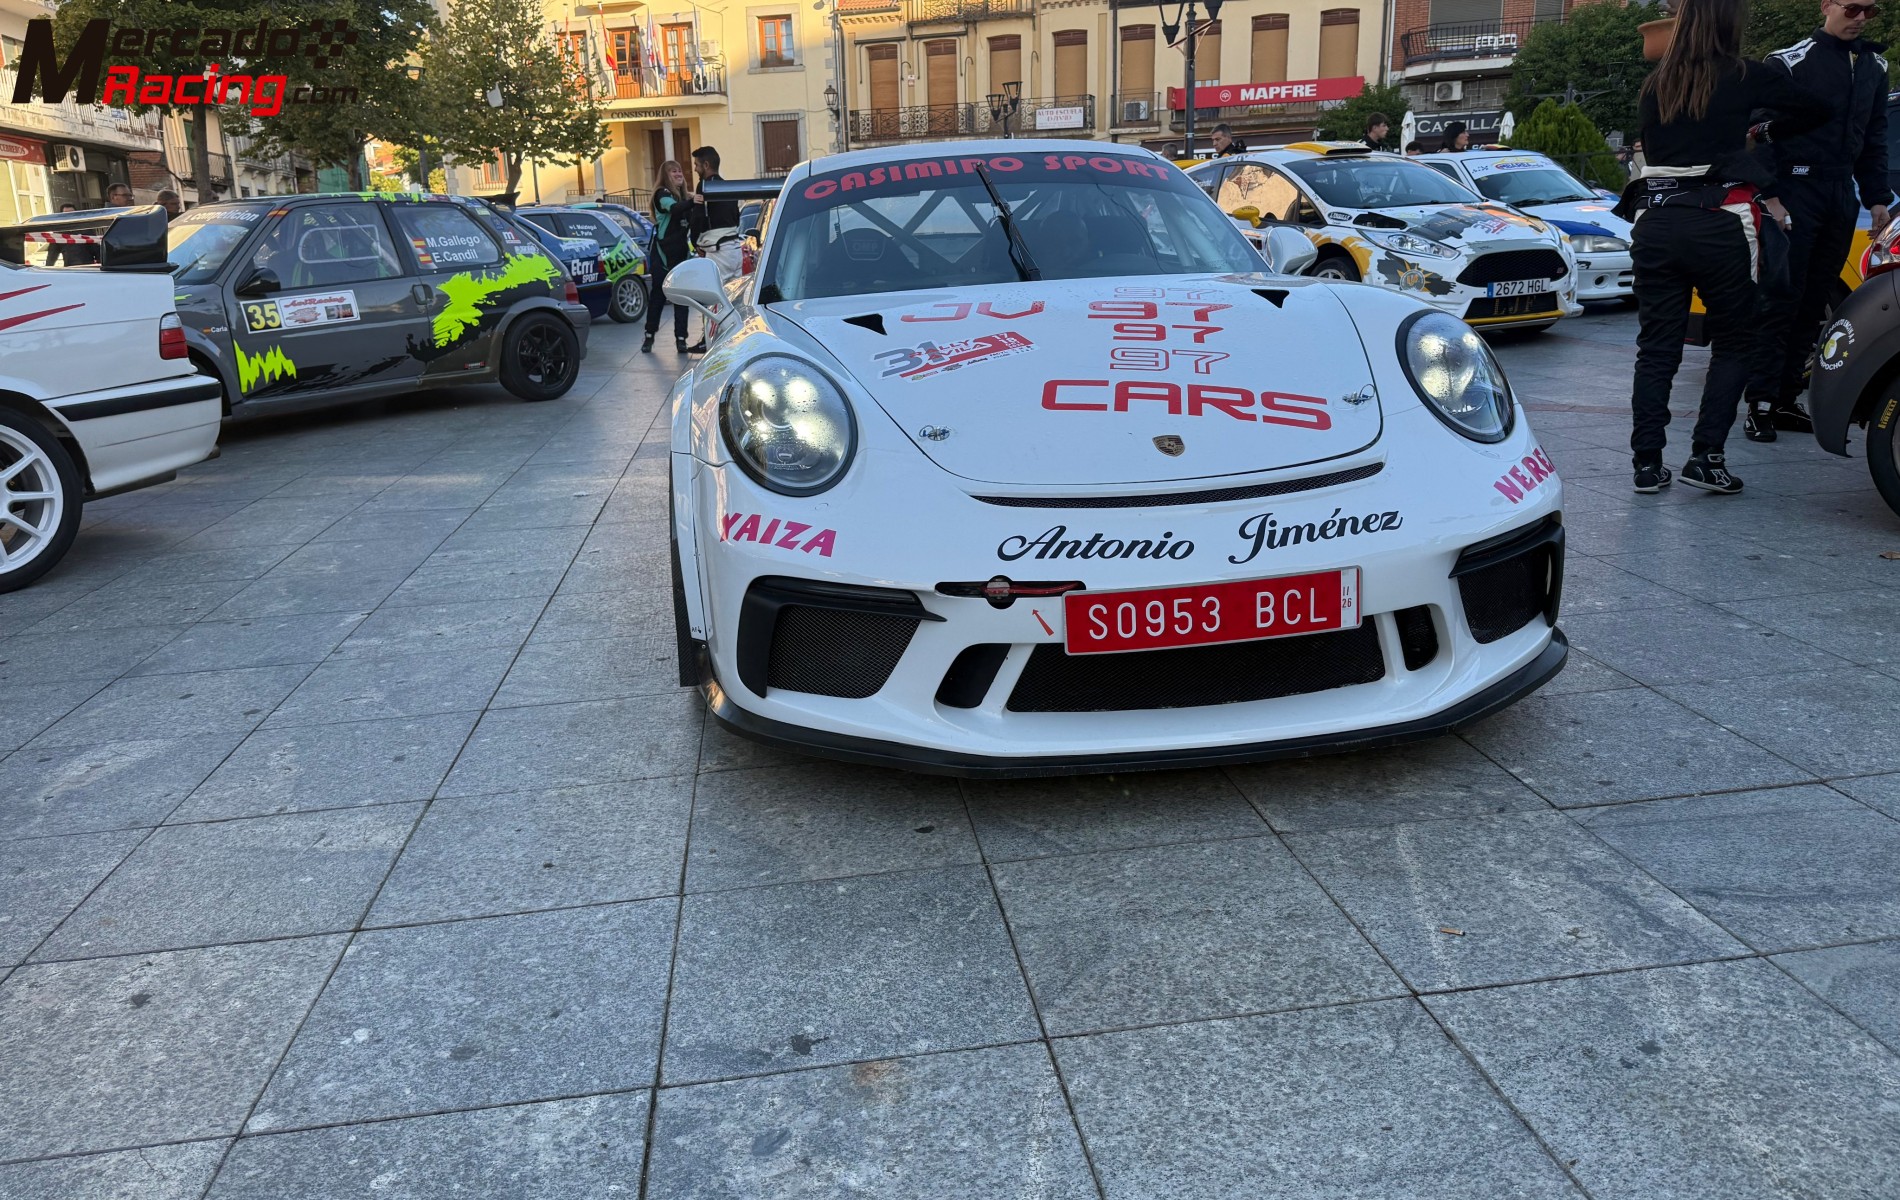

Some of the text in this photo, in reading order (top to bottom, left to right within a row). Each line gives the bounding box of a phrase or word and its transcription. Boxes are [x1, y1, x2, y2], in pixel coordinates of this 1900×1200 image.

[1240, 83, 1317, 101] MAPFRE
[610, 109, 678, 119] CONSISTORIAL
[804, 155, 1170, 200] CASIMIRO SPORT
[425, 235, 481, 248] M.Gallego
[432, 249, 479, 263] E.Candil
[582, 272, 599, 284] SPORT
[1495, 280, 1547, 297] 2672 HGL
[247, 303, 283, 330] 35
[1088, 300, 1234, 322] 97
[211, 326, 229, 334] Carla
[1113, 323, 1225, 344] 97
[873, 340, 946, 378] 31
[1109, 347, 1231, 375] 97
[1041, 379, 1332, 431] CARS
[1878, 398, 1898, 430] PIRELLI
[1493, 444, 1557, 505] NERE
[718, 512, 838, 558] YAIZA
[997, 507, 1404, 565] Antonio Jiménez
[1088, 587, 1328, 641] S0953 BCL
[1341, 597, 1352, 609] 26
